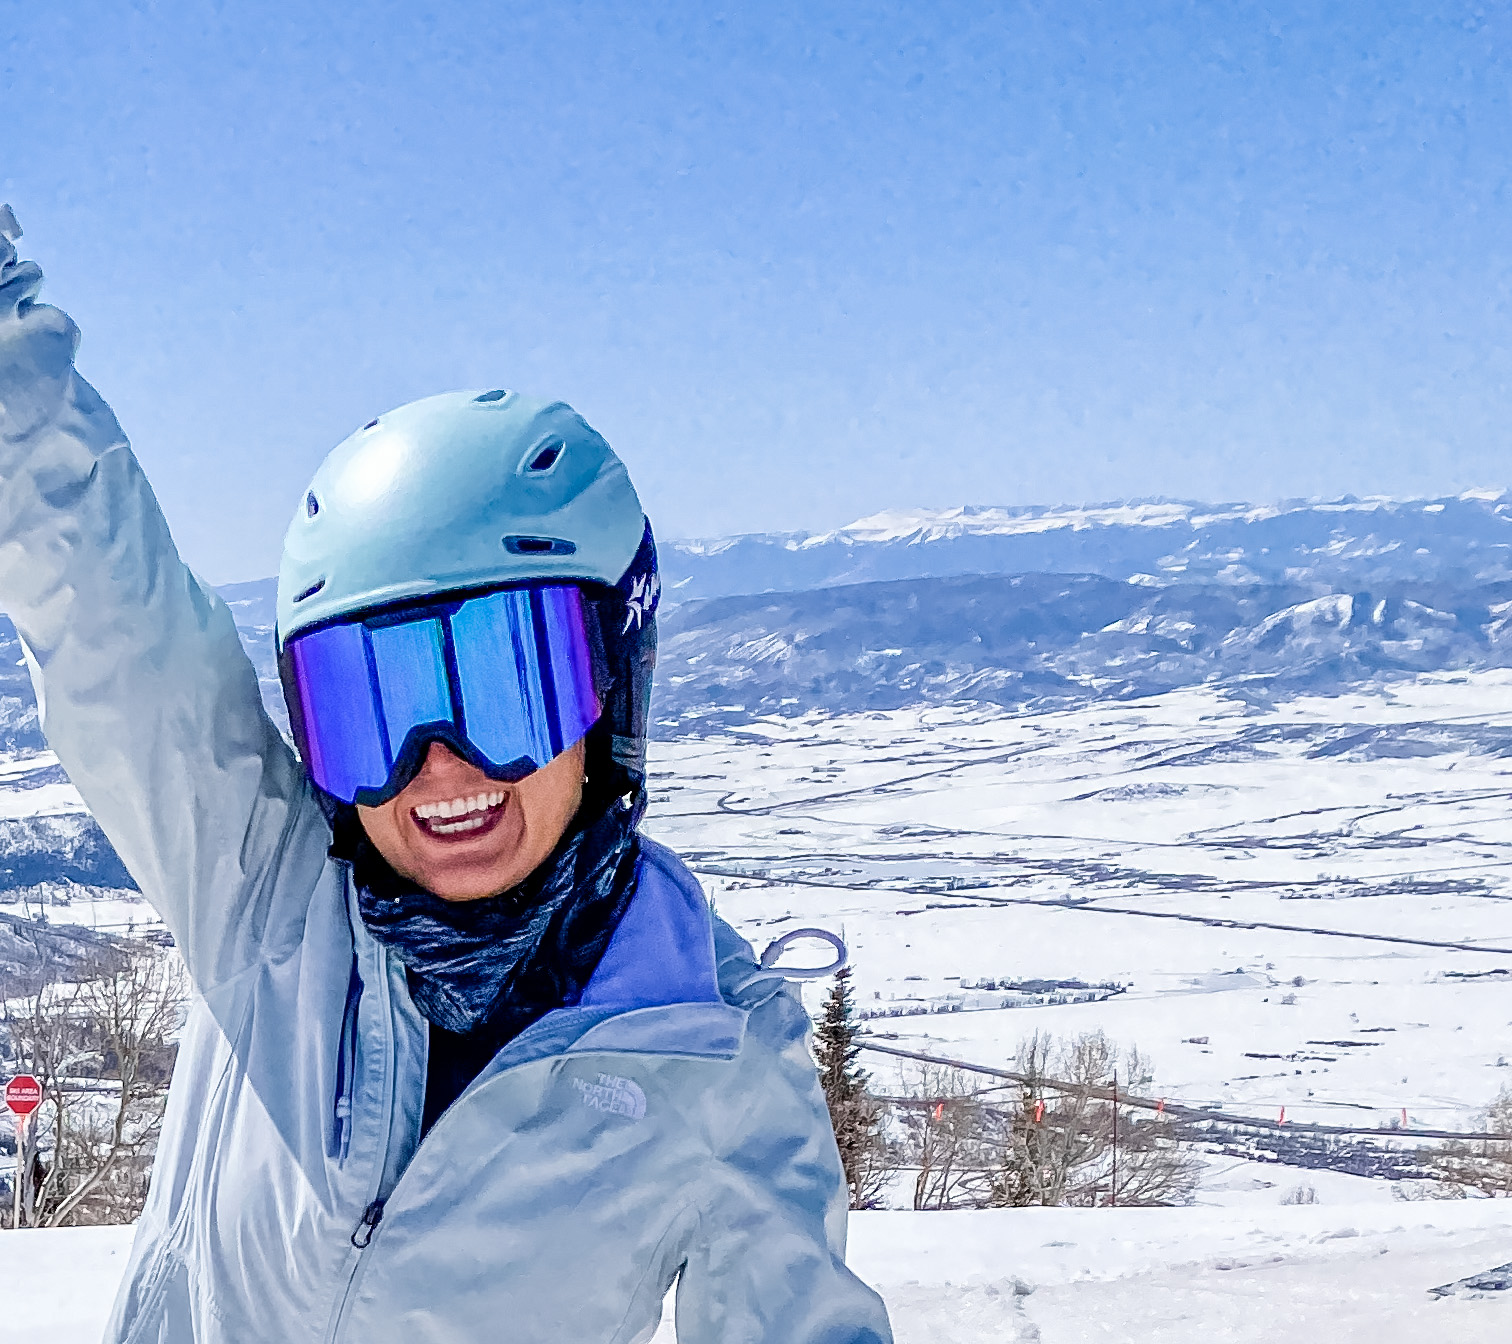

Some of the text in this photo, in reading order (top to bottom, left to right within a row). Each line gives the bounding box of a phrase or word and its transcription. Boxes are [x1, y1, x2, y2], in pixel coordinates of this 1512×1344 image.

[598, 1072, 626, 1089] THE
[21, 1087, 38, 1095] AREA
[572, 1078, 623, 1101] NORTH
